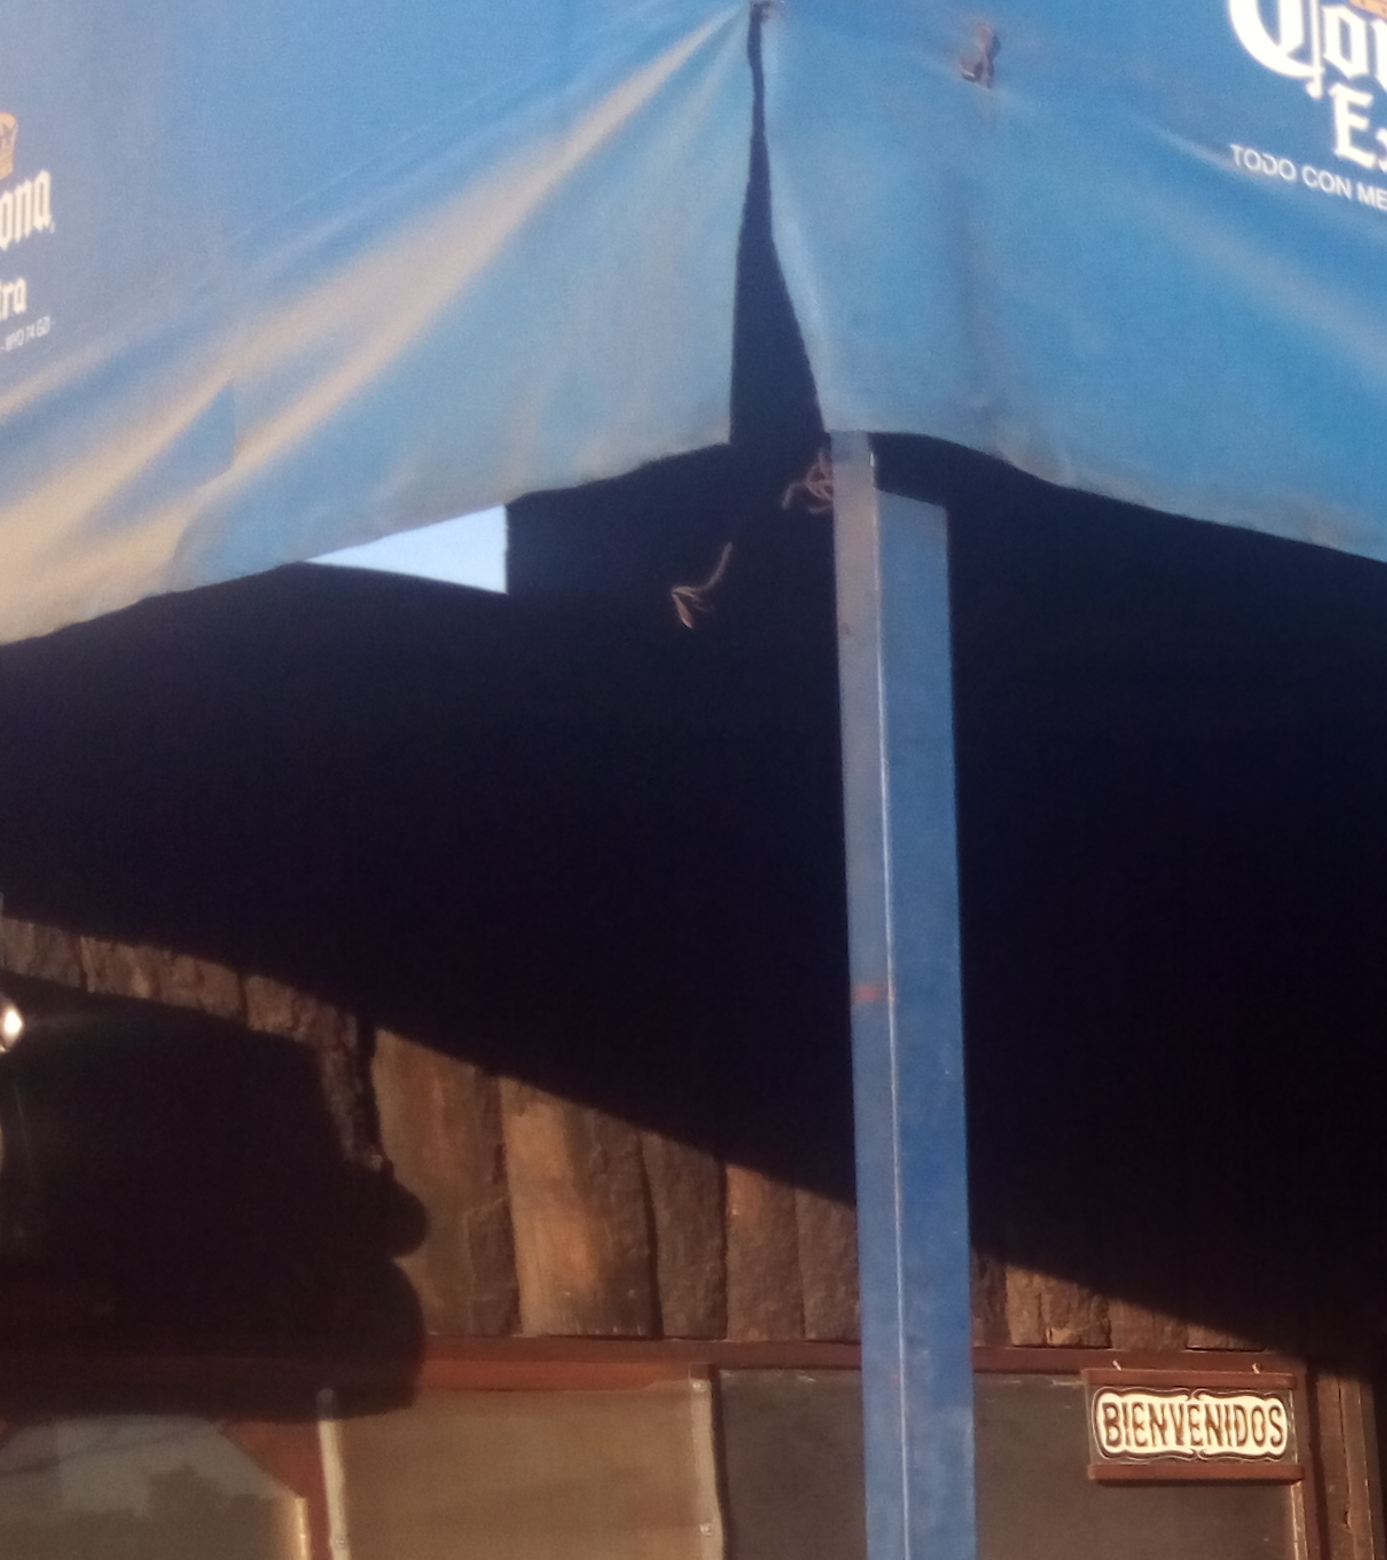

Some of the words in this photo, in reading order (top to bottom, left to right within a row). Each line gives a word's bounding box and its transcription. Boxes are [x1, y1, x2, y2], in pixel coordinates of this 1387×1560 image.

[1230, 143, 1297, 181] TODO
[1301, 165, 1352, 201] CON
[1101, 1402, 1284, 1448] BIENVENIDOS
